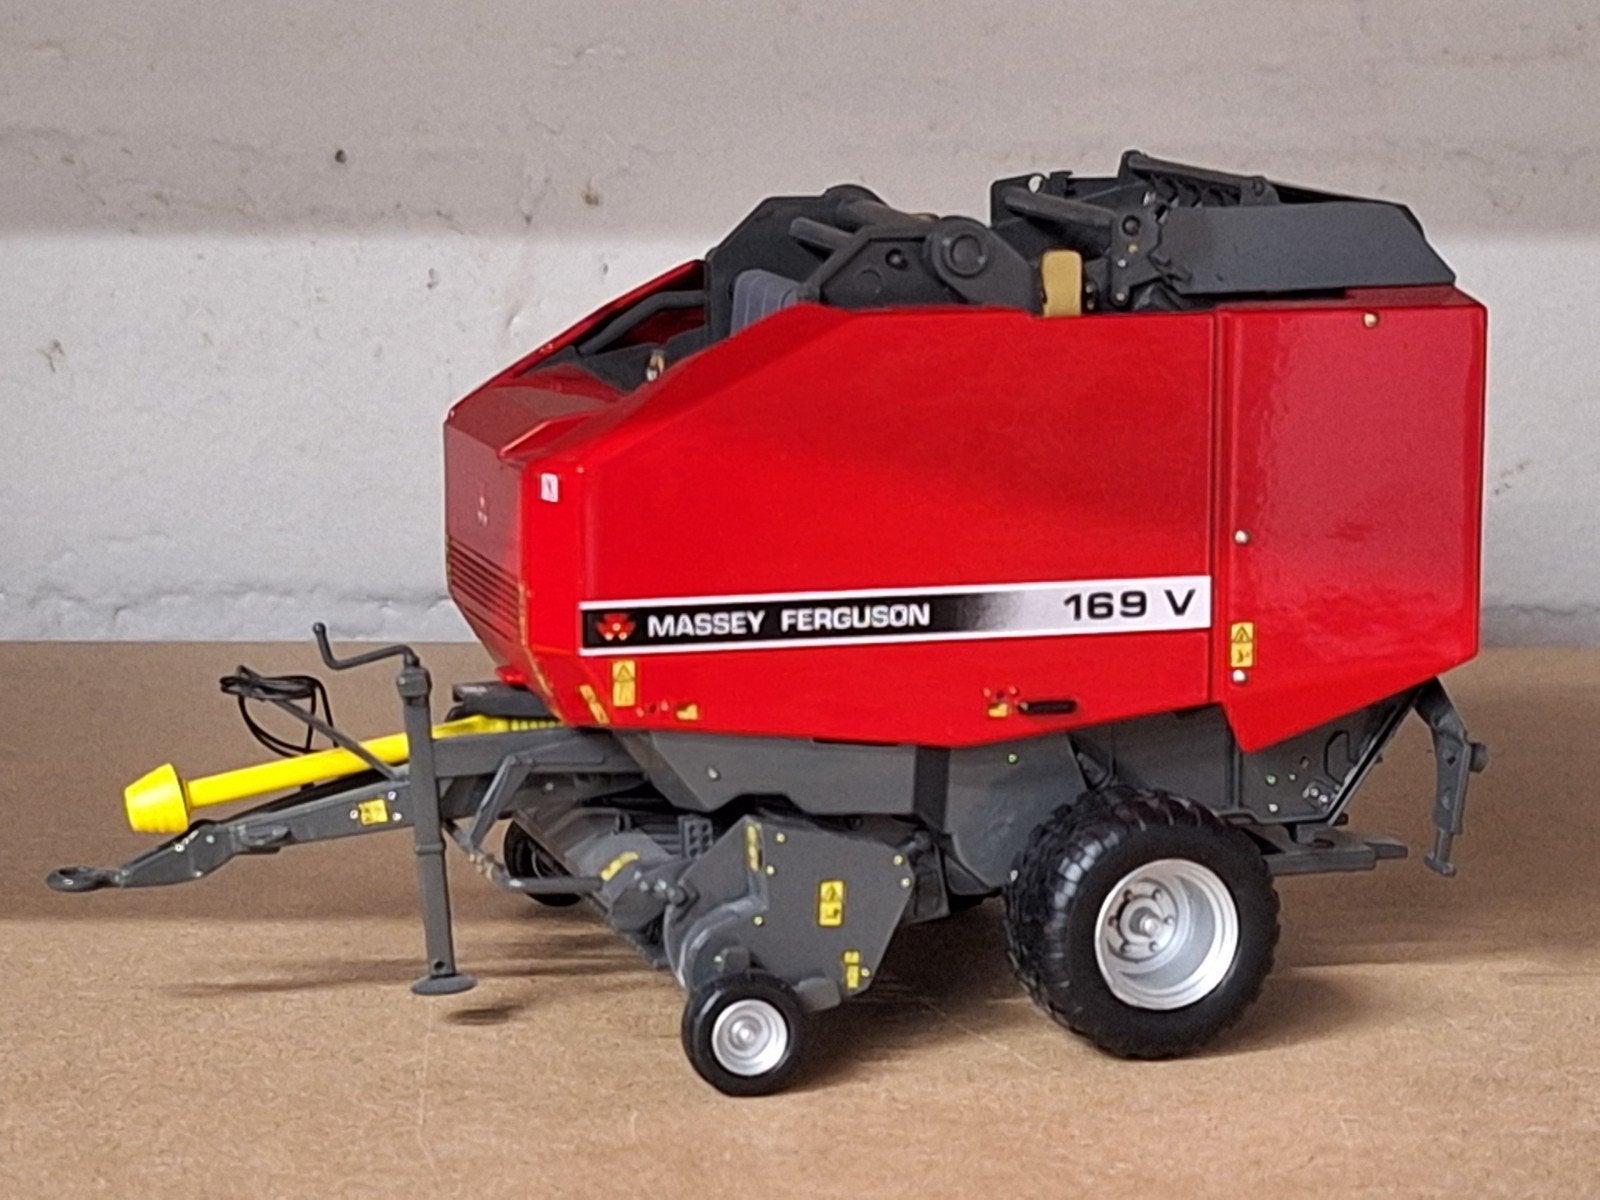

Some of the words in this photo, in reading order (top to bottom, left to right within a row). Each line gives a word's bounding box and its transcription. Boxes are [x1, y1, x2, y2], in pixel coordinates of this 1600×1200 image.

[647, 610, 766, 639] MASSEY
[780, 602, 931, 633] FERGUSON
[1064, 590, 1147, 621] 169
[1165, 588, 1196, 616] V
